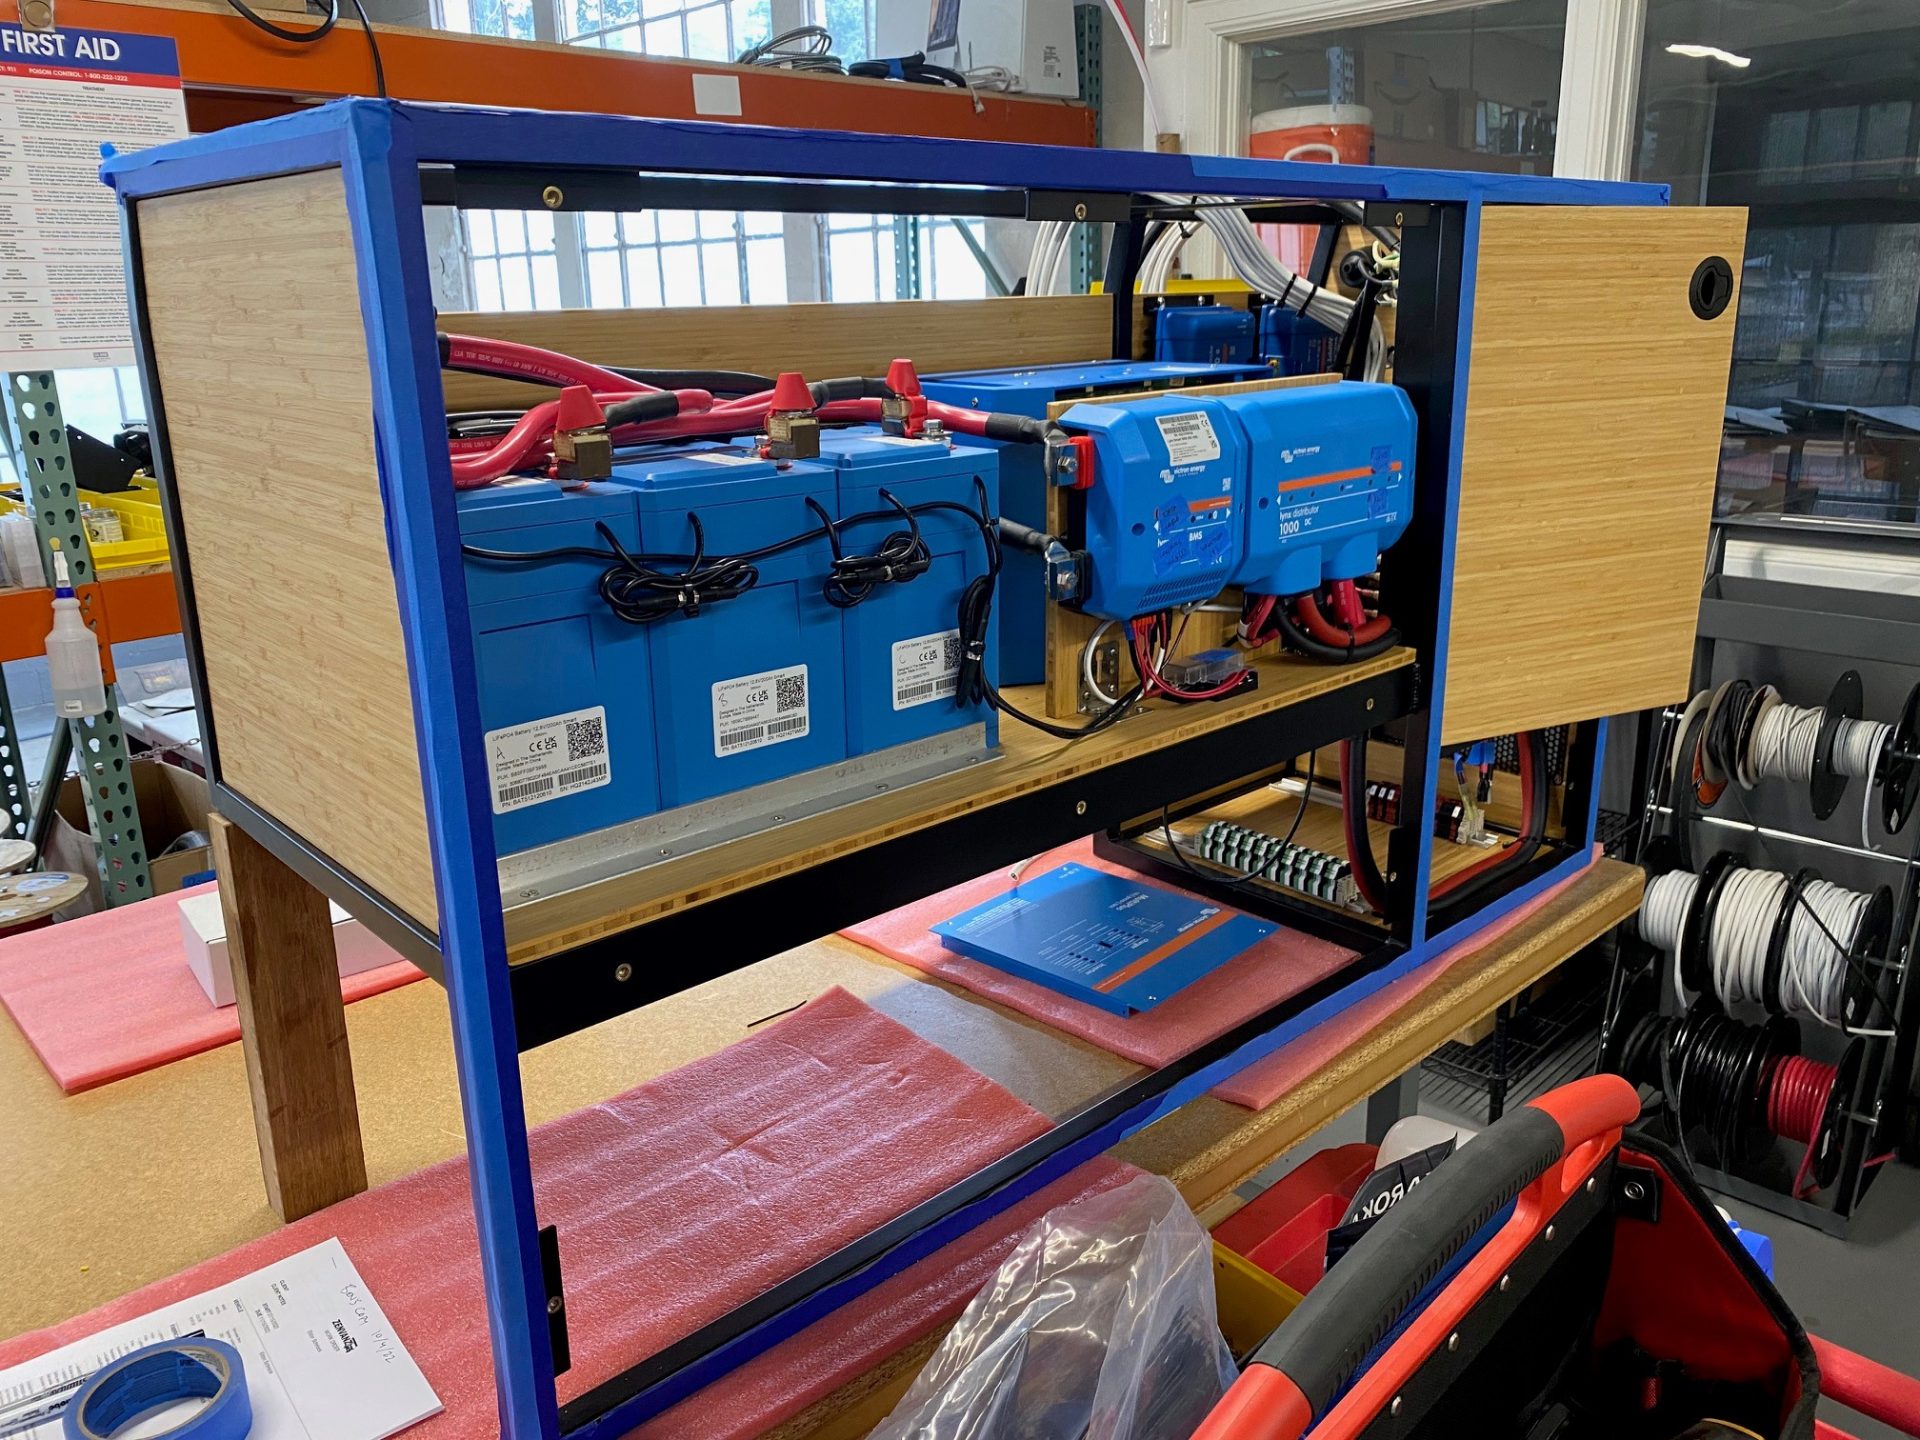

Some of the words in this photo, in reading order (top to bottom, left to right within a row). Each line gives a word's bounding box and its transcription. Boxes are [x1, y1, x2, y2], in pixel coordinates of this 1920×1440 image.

[1, 29, 66, 57] FIRST
[75, 36, 120, 61] AID
[28, 67, 52, 75] POISON
[52, 69, 83, 78] CONTROL:
[84, 72, 129, 82] 1-800-222-1222
[1280, 510, 1292, 522] lynx
[1292, 506, 1319, 518] distributor
[1280, 520, 1299, 535] 1000
[1304, 518, 1312, 526] DC
[1189, 531, 1203, 542] BMS
[515, 728, 531, 736] Battery
[545, 742, 557, 750] CA
